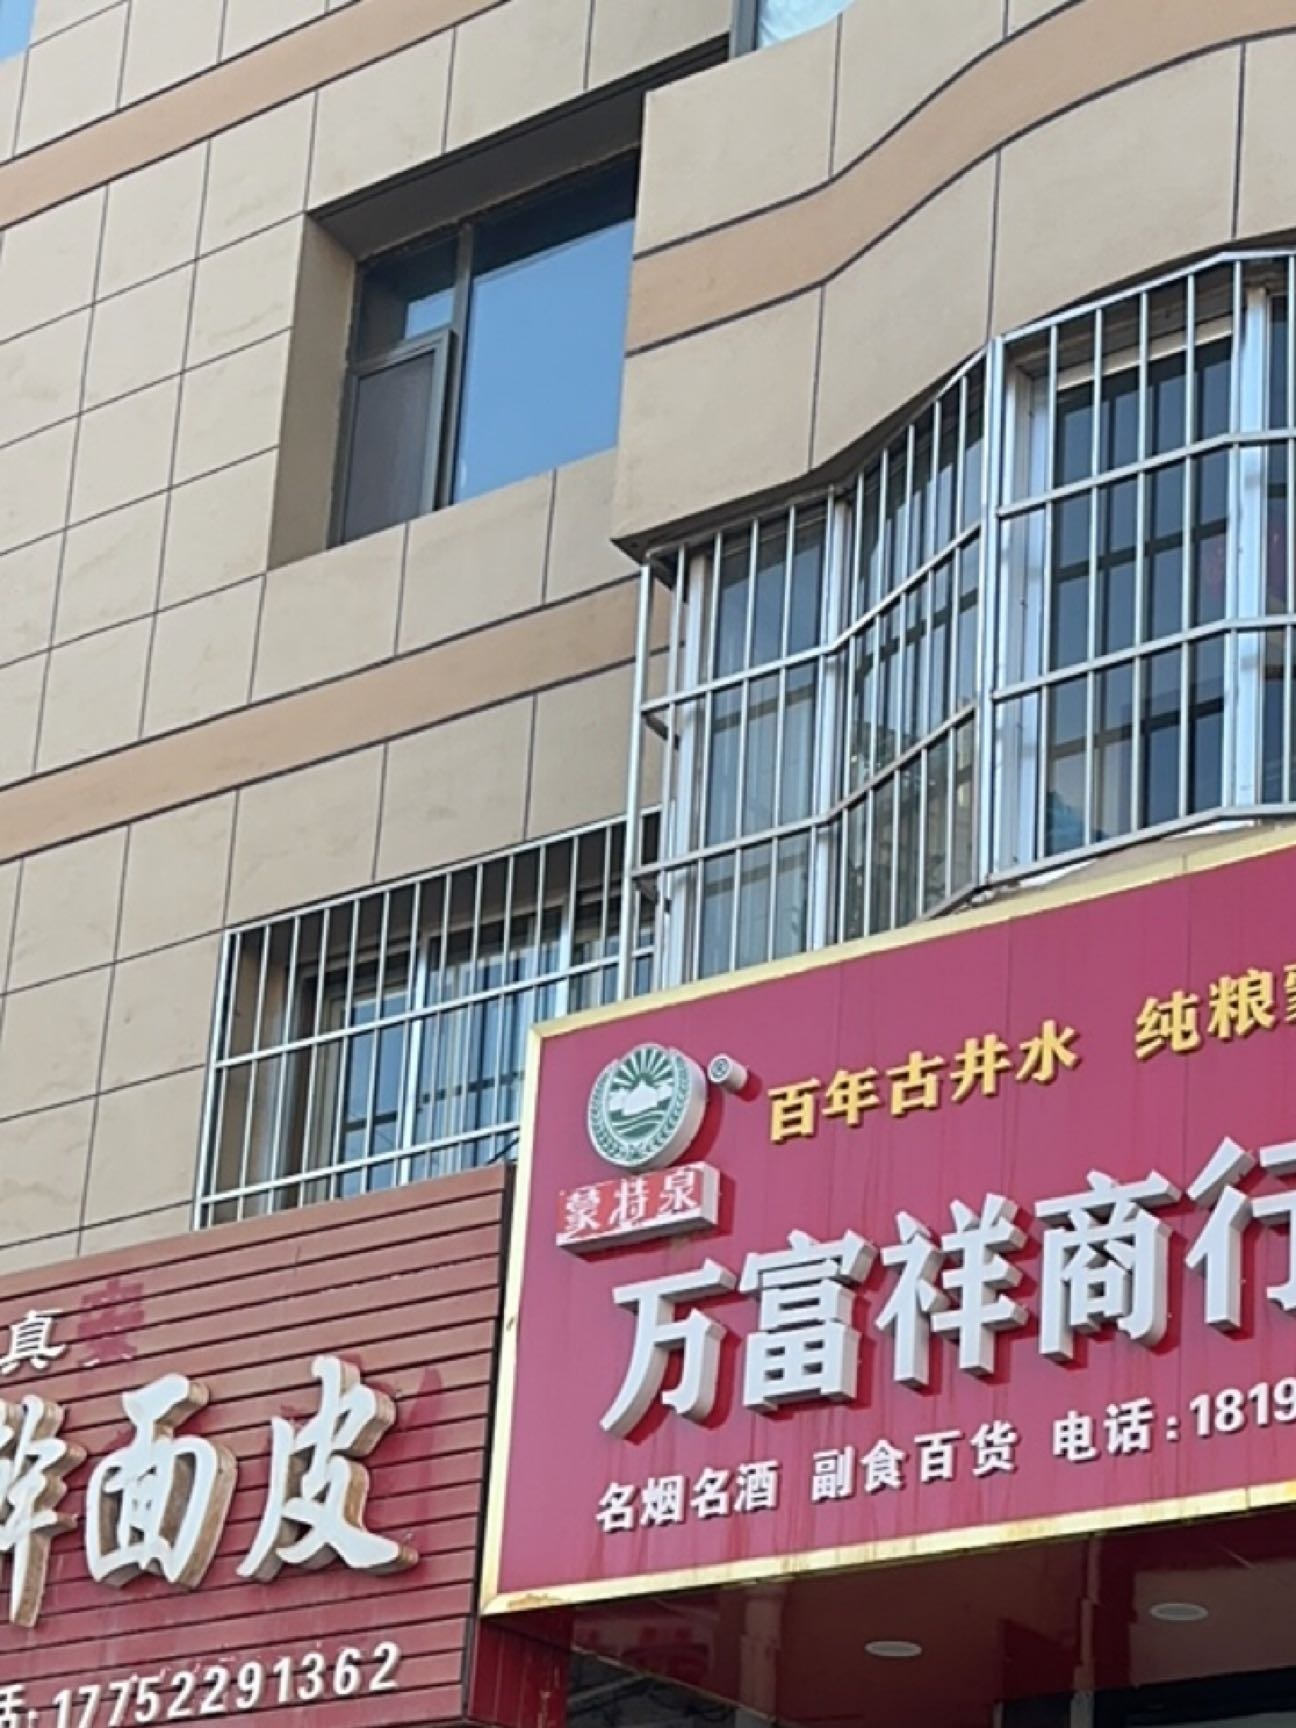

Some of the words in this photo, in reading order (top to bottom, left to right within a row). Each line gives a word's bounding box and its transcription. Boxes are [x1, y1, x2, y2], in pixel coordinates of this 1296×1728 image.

[766, 1018, 1080, 1142] 百年古井水
[596, 1457, 780, 1534] 名烟名酒
[810, 1420, 1020, 1502] 副食百货
